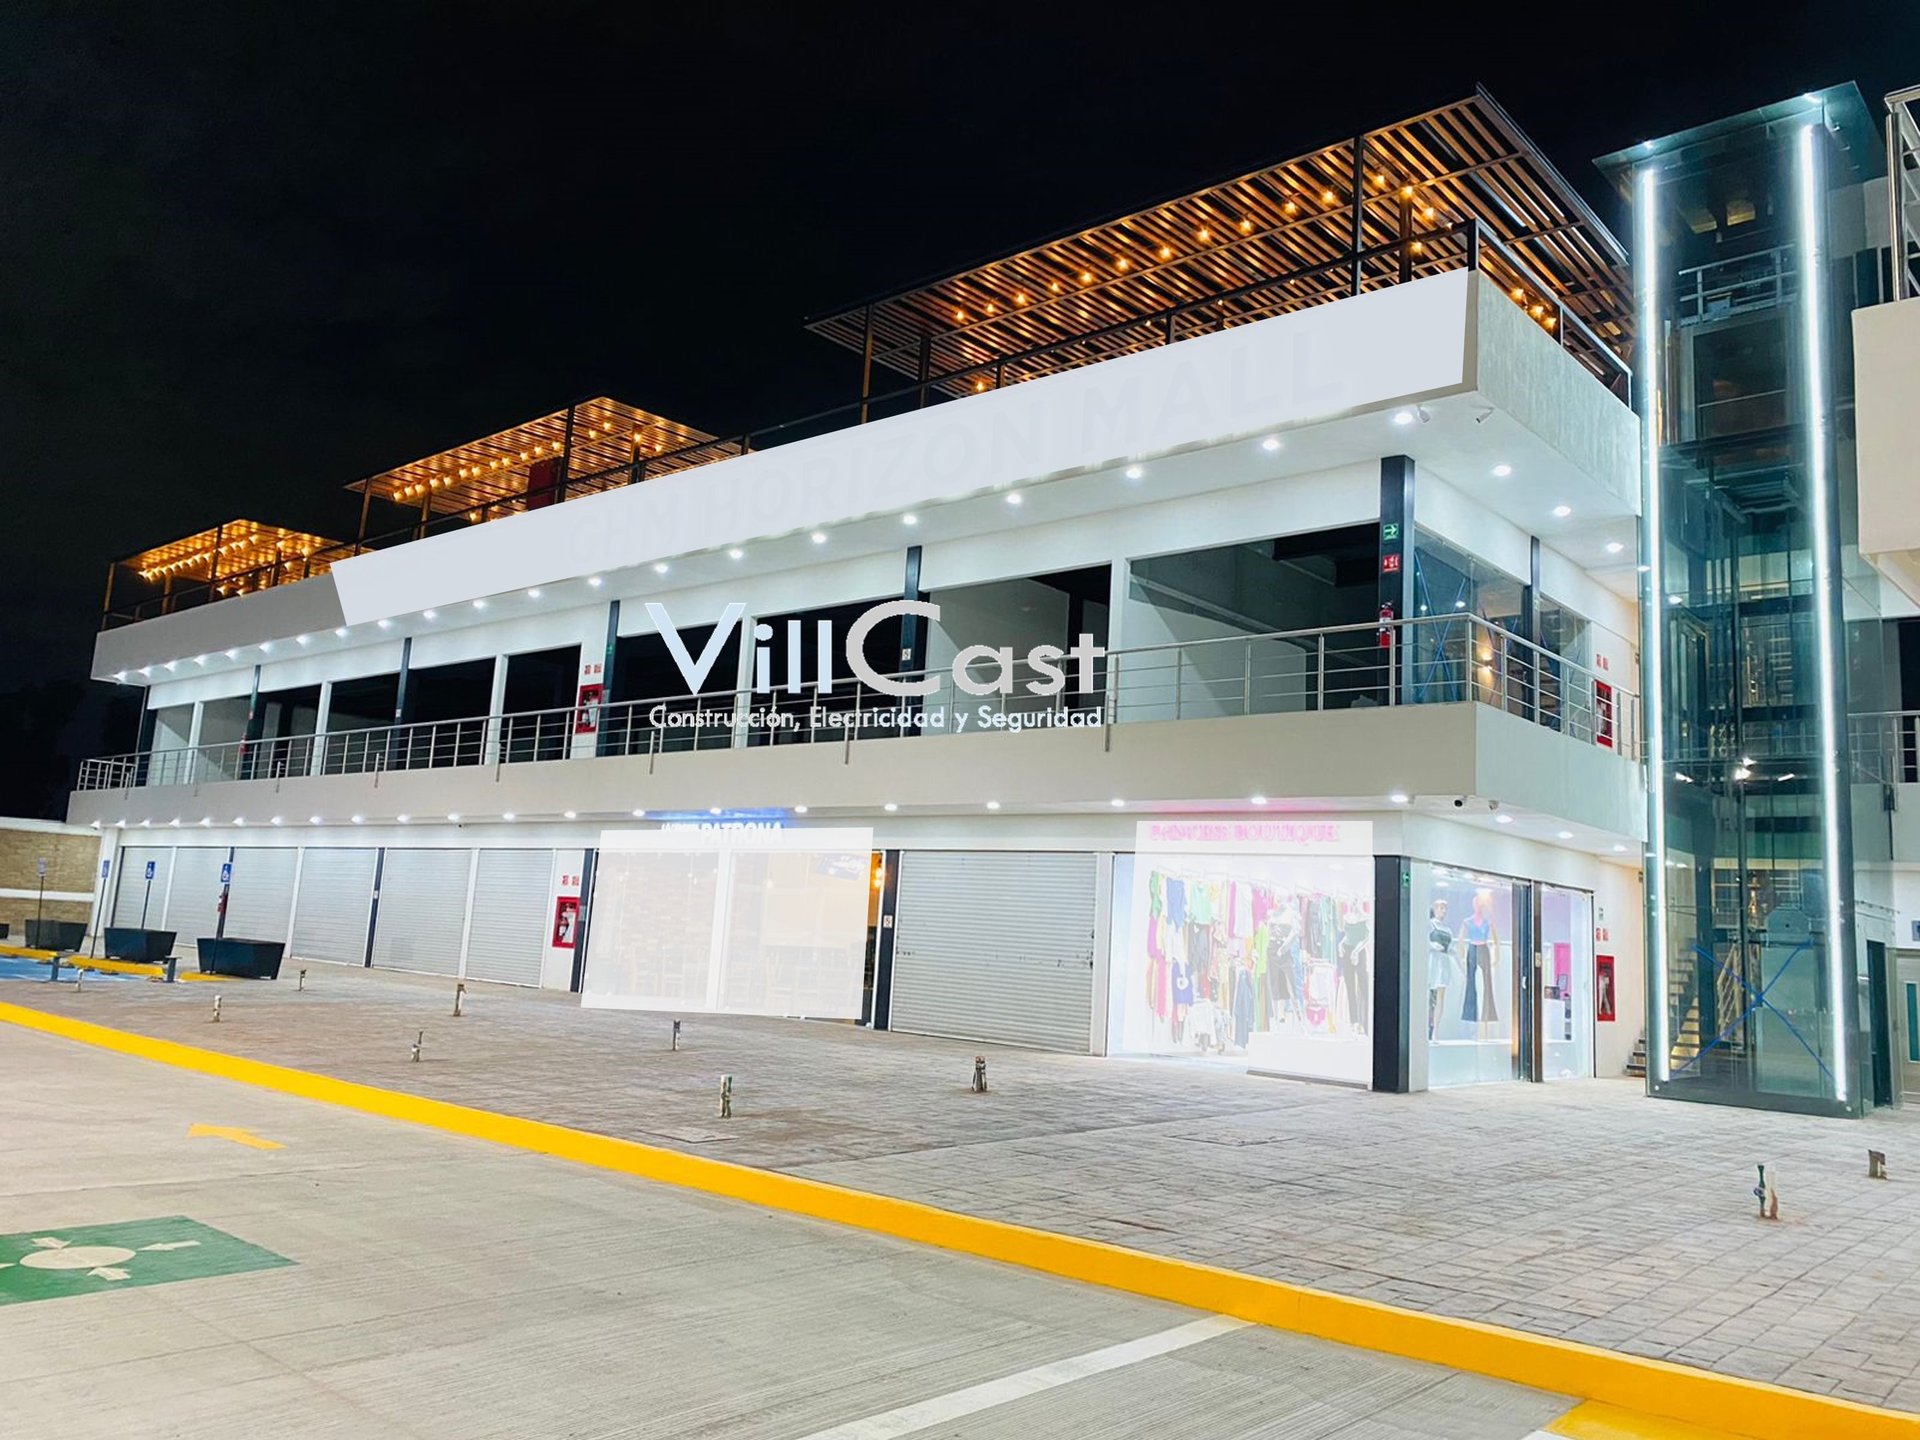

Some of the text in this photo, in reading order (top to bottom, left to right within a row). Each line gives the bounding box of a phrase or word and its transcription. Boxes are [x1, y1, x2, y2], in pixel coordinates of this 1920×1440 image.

[705, 401, 1050, 537] HORIZON
[1080, 329, 1346, 454] MALL
[1234, 824, 1341, 846] BOUTIQUE
